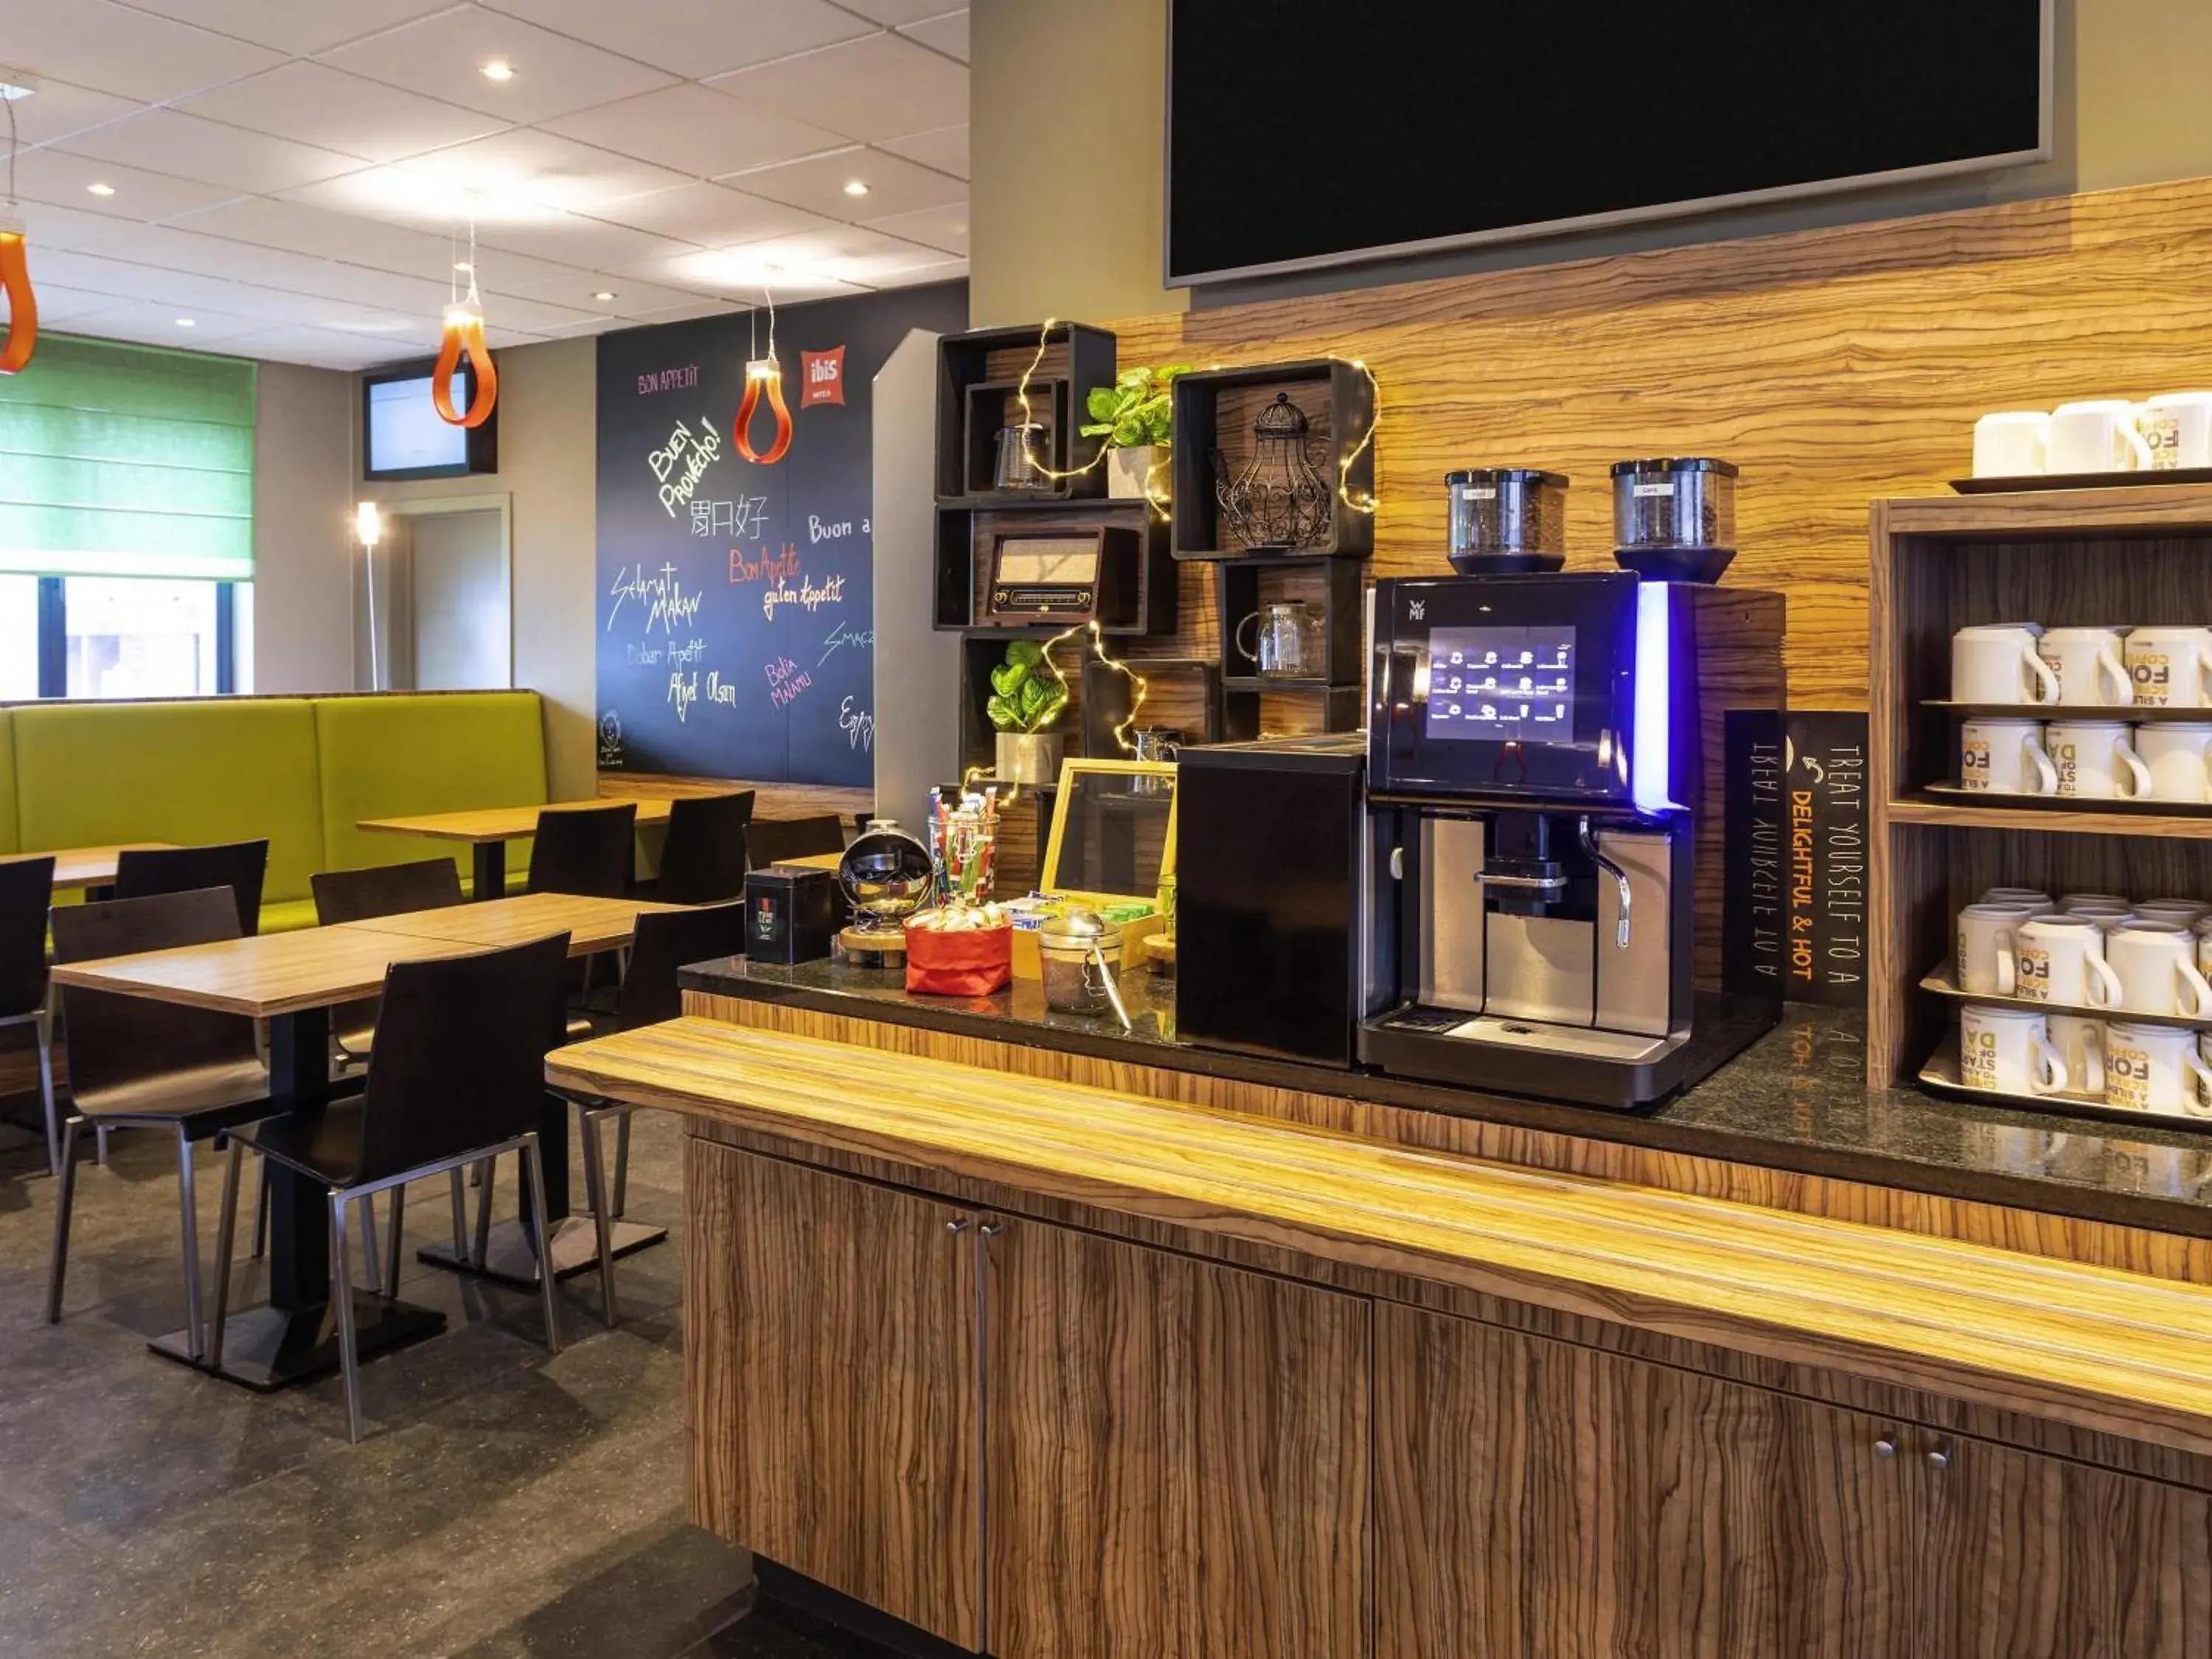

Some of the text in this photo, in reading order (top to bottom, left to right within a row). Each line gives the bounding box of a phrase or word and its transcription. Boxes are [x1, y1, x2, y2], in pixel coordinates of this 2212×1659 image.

[810, 359, 838, 383] ibis
[638, 374, 658, 394] BON
[2143, 430, 2179, 451] FO
[808, 515, 872, 543] Buon a
[2132, 695, 2155, 706] SILE
[1964, 751, 1990, 769] FO
[2048, 743, 2076, 761] DA
[1828, 745, 1863, 984] TREAT YOURSELF TO A
[1792, 790, 1813, 981] DELIGHTFUL & HOT
[2021, 957, 2050, 978] FO
[1966, 1028, 1996, 1050] DA
